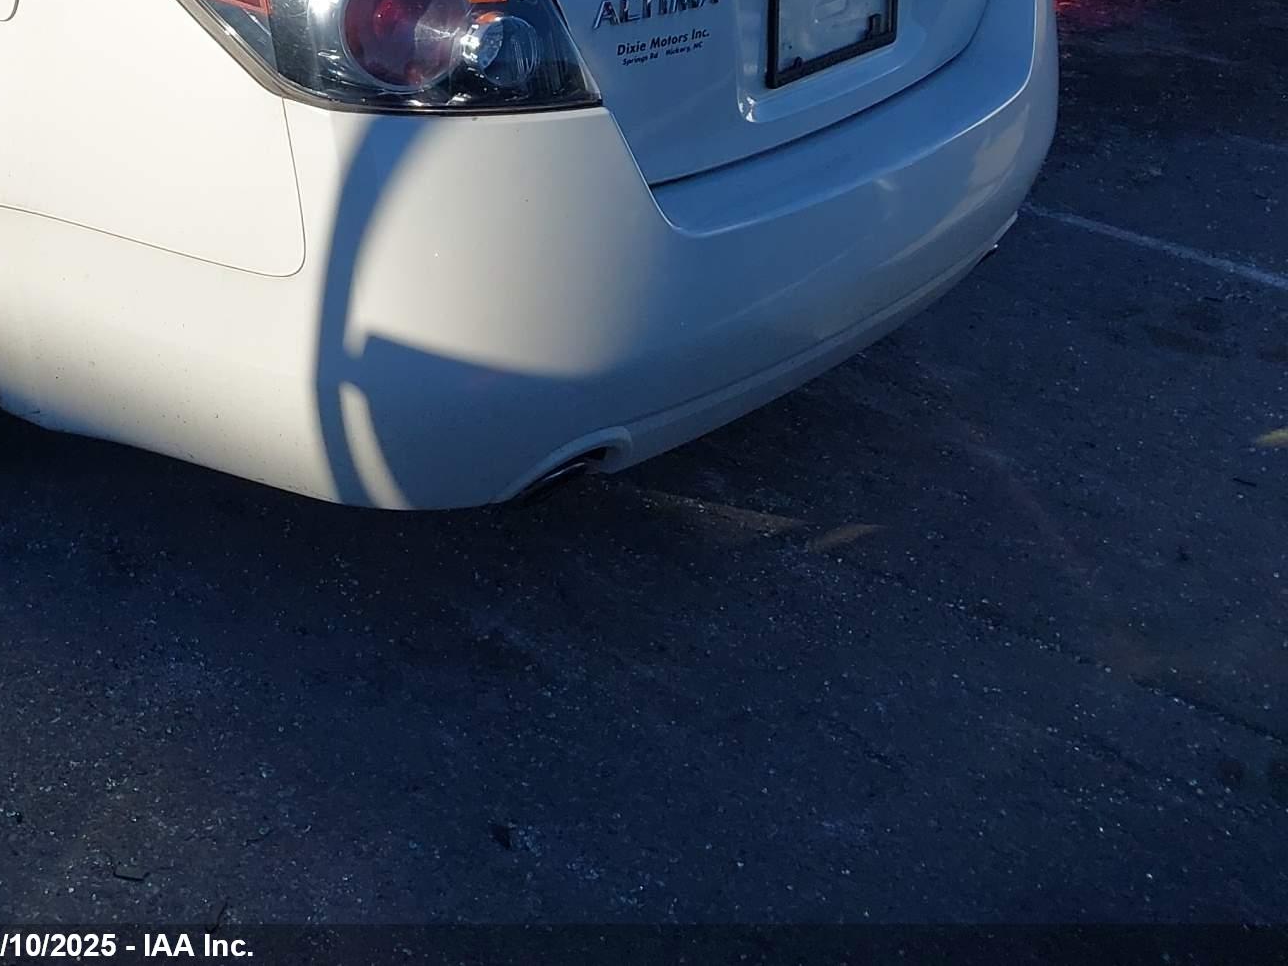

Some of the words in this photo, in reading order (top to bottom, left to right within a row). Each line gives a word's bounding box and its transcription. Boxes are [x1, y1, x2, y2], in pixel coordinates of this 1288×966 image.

[617, 40, 647, 56] Dixie
[649, 33, 688, 50] Motors
[691, 28, 710, 41] Inc.
[622, 54, 648, 66] Springs
